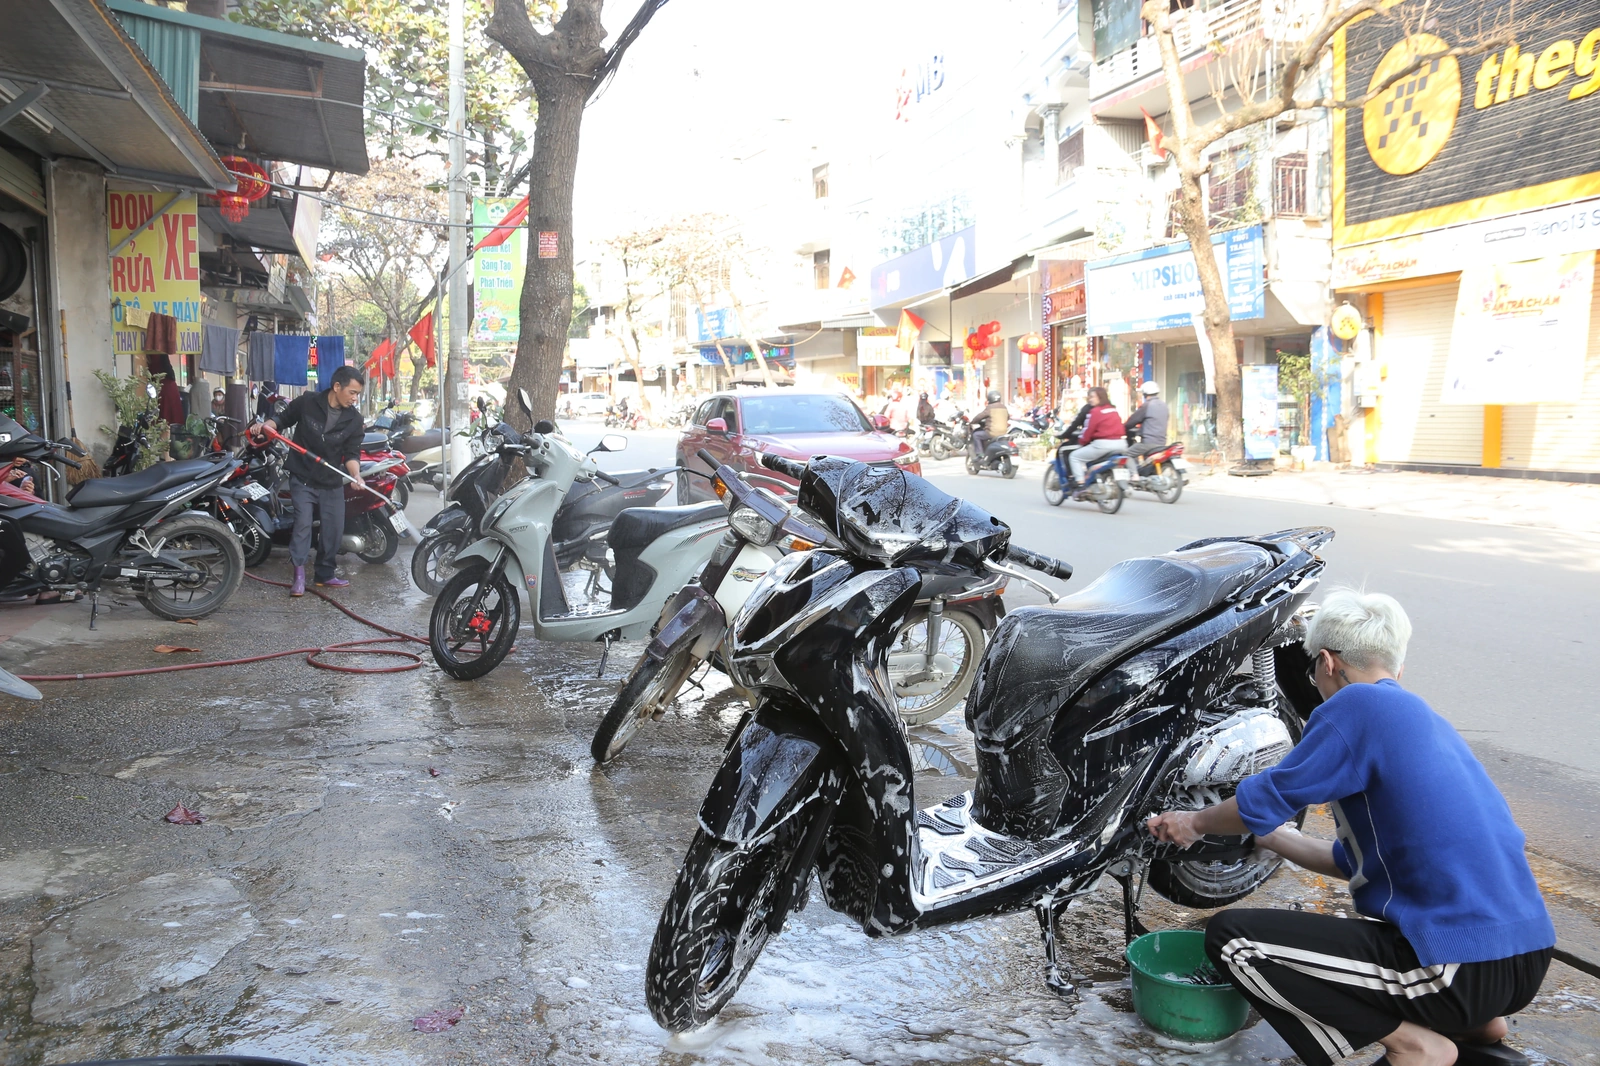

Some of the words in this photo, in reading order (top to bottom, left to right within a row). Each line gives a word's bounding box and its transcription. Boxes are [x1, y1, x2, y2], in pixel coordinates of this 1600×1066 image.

[161, 214, 198, 280] XE
[1132, 261, 1202, 291] MIPSHO
[173, 297, 199, 322] MÁY
[116, 331, 137, 351] THAY
